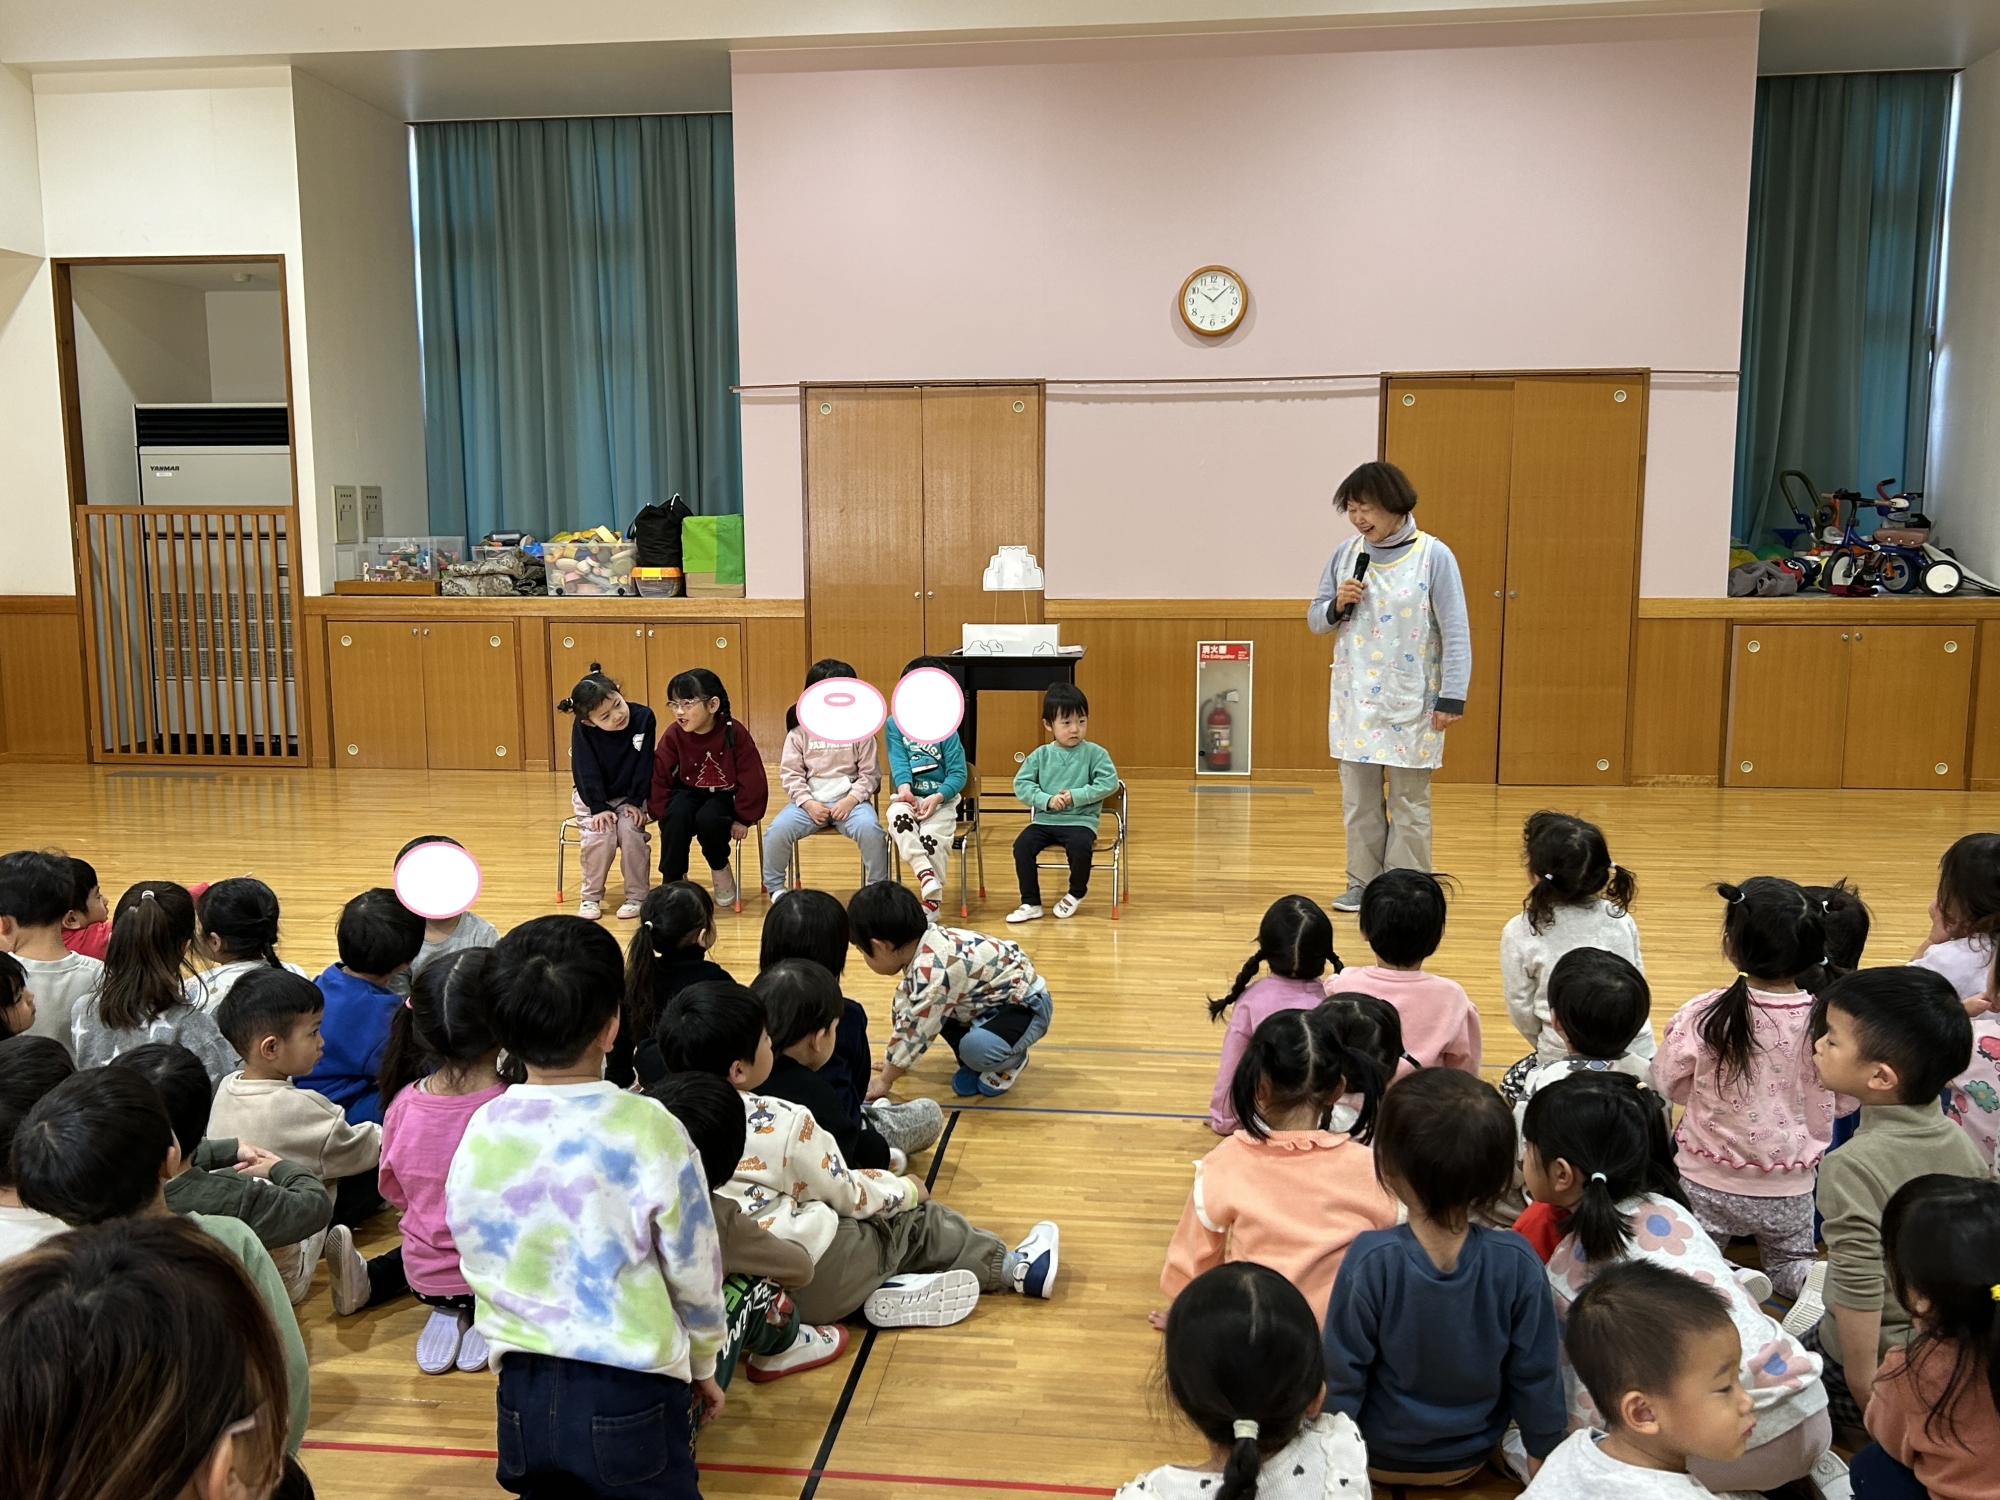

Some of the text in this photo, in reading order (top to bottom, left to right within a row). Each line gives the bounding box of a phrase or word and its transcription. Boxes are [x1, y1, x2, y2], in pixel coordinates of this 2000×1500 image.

[1200, 278, 1207, 286] 11
[1210, 275, 1218, 283] 12
[1192, 286, 1200, 294] 10
[1229, 286, 1235, 294] 2
[1232, 297, 1238, 305] 3
[1191, 308, 1198, 316] 8
[1228, 308, 1234, 316] 4
[1199, 316, 1205, 324] 7
[1209, 319, 1215, 327] 6
[1202, 645, 1227, 654] 消火器
